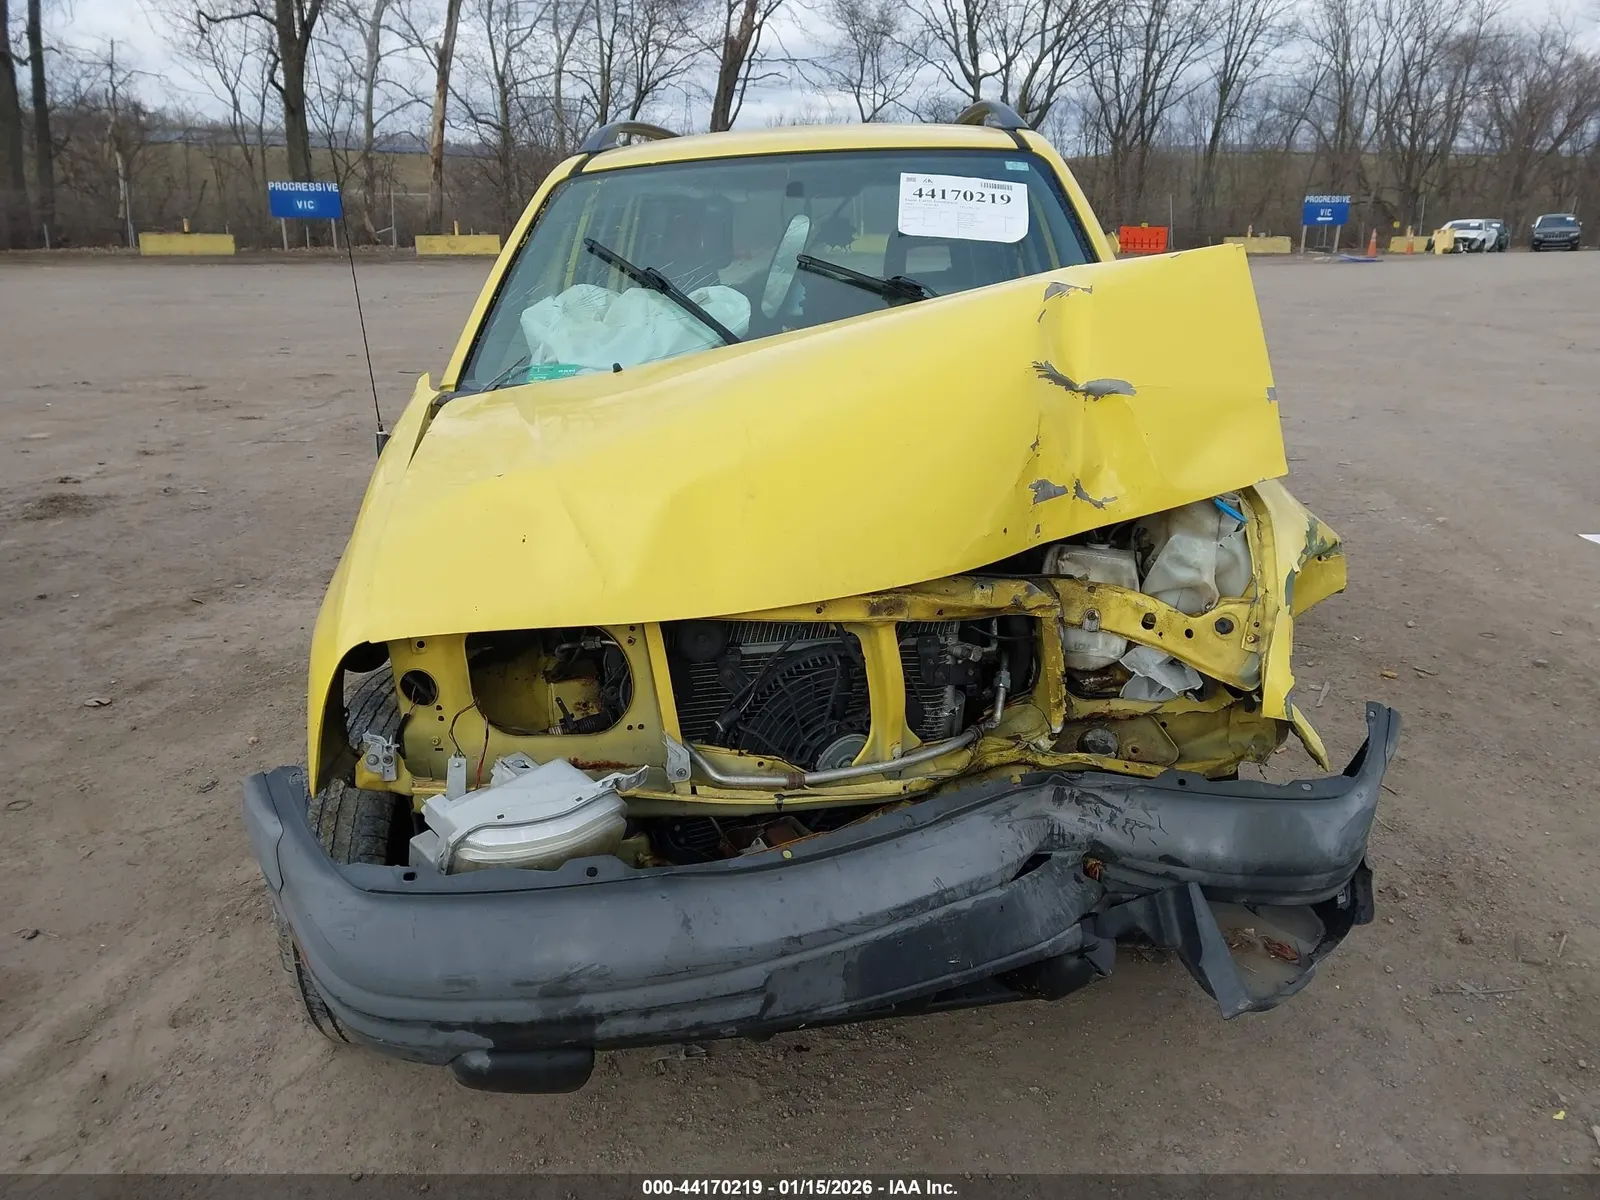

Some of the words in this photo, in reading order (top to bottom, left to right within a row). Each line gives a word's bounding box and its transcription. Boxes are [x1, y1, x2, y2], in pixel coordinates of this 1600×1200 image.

[267, 181, 339, 192] PROGRESSIVE
[912, 187, 1012, 205] 44170219
[1304, 195, 1351, 203] PROGRESSIVE
[296, 200, 315, 210] VIC
[1320, 208, 1332, 216] VIC
